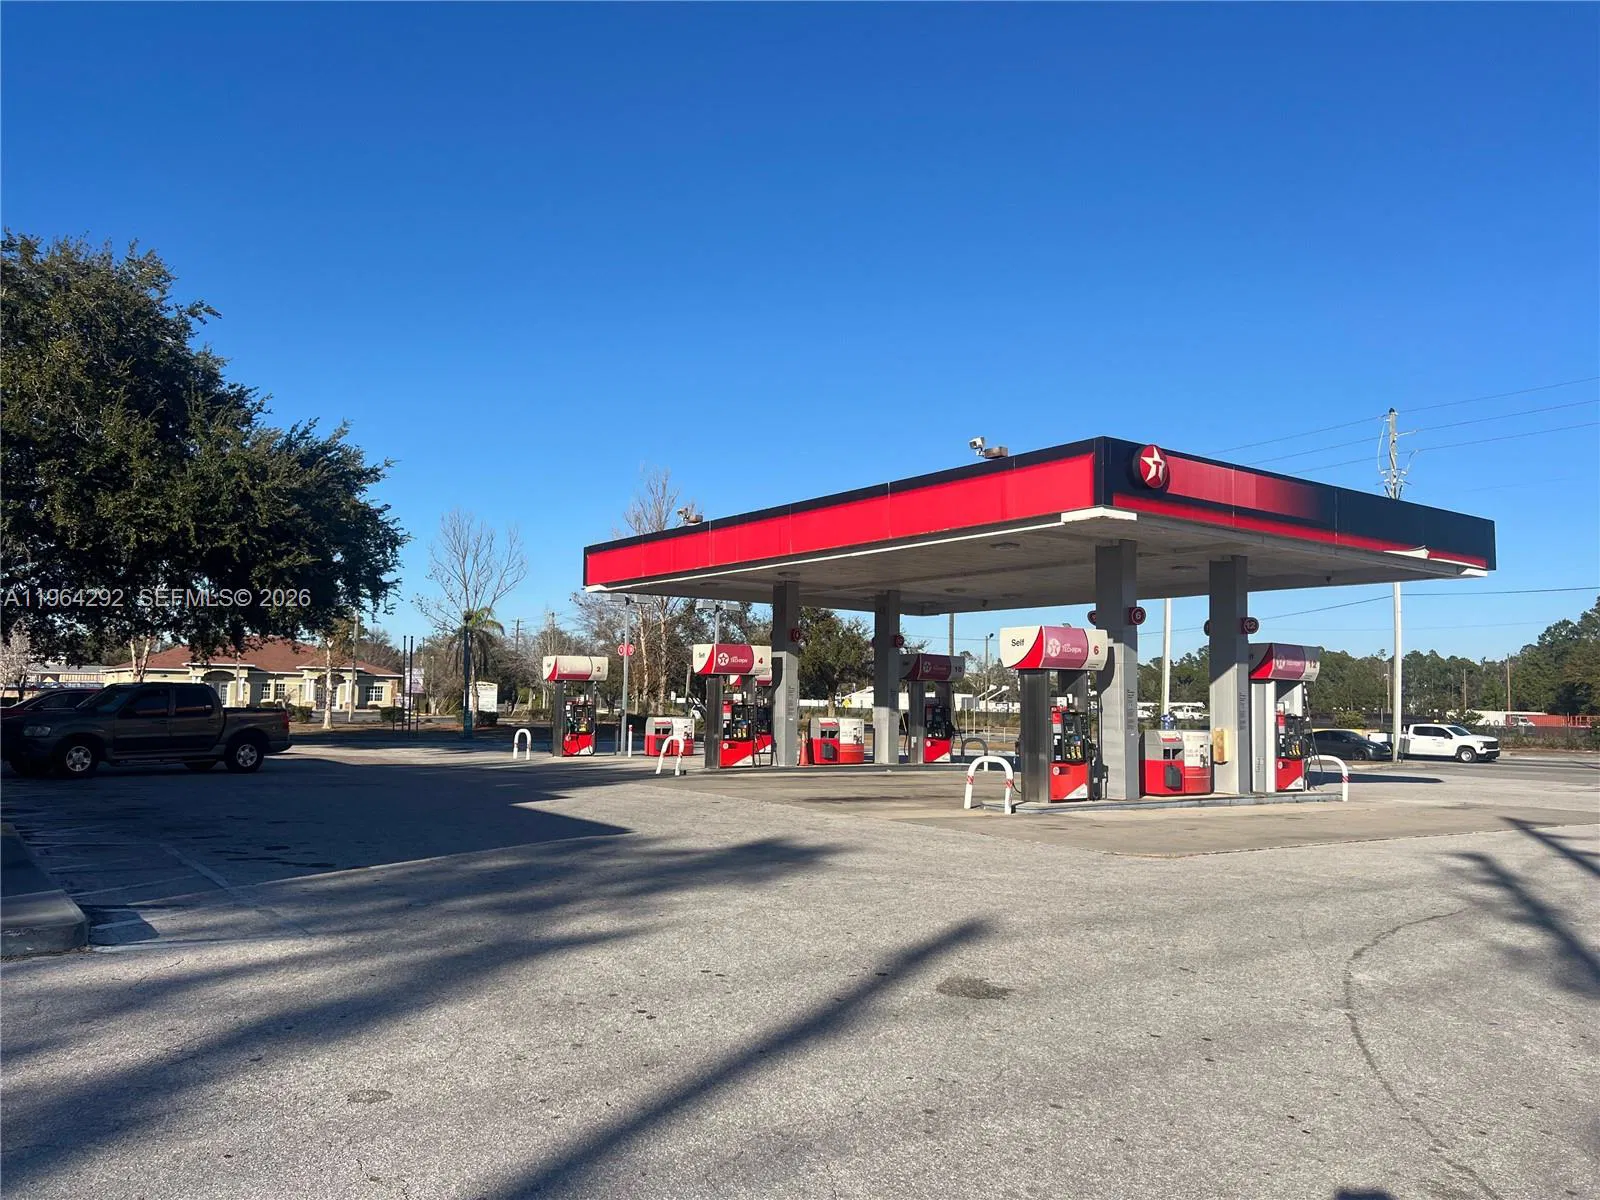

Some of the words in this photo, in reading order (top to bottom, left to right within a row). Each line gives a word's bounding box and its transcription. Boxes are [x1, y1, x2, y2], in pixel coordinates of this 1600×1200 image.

[1011, 638, 1025, 648] Self
[1093, 645, 1099, 655] 6
[758, 657, 764, 665] 4
[1309, 661, 1317, 669] 12
